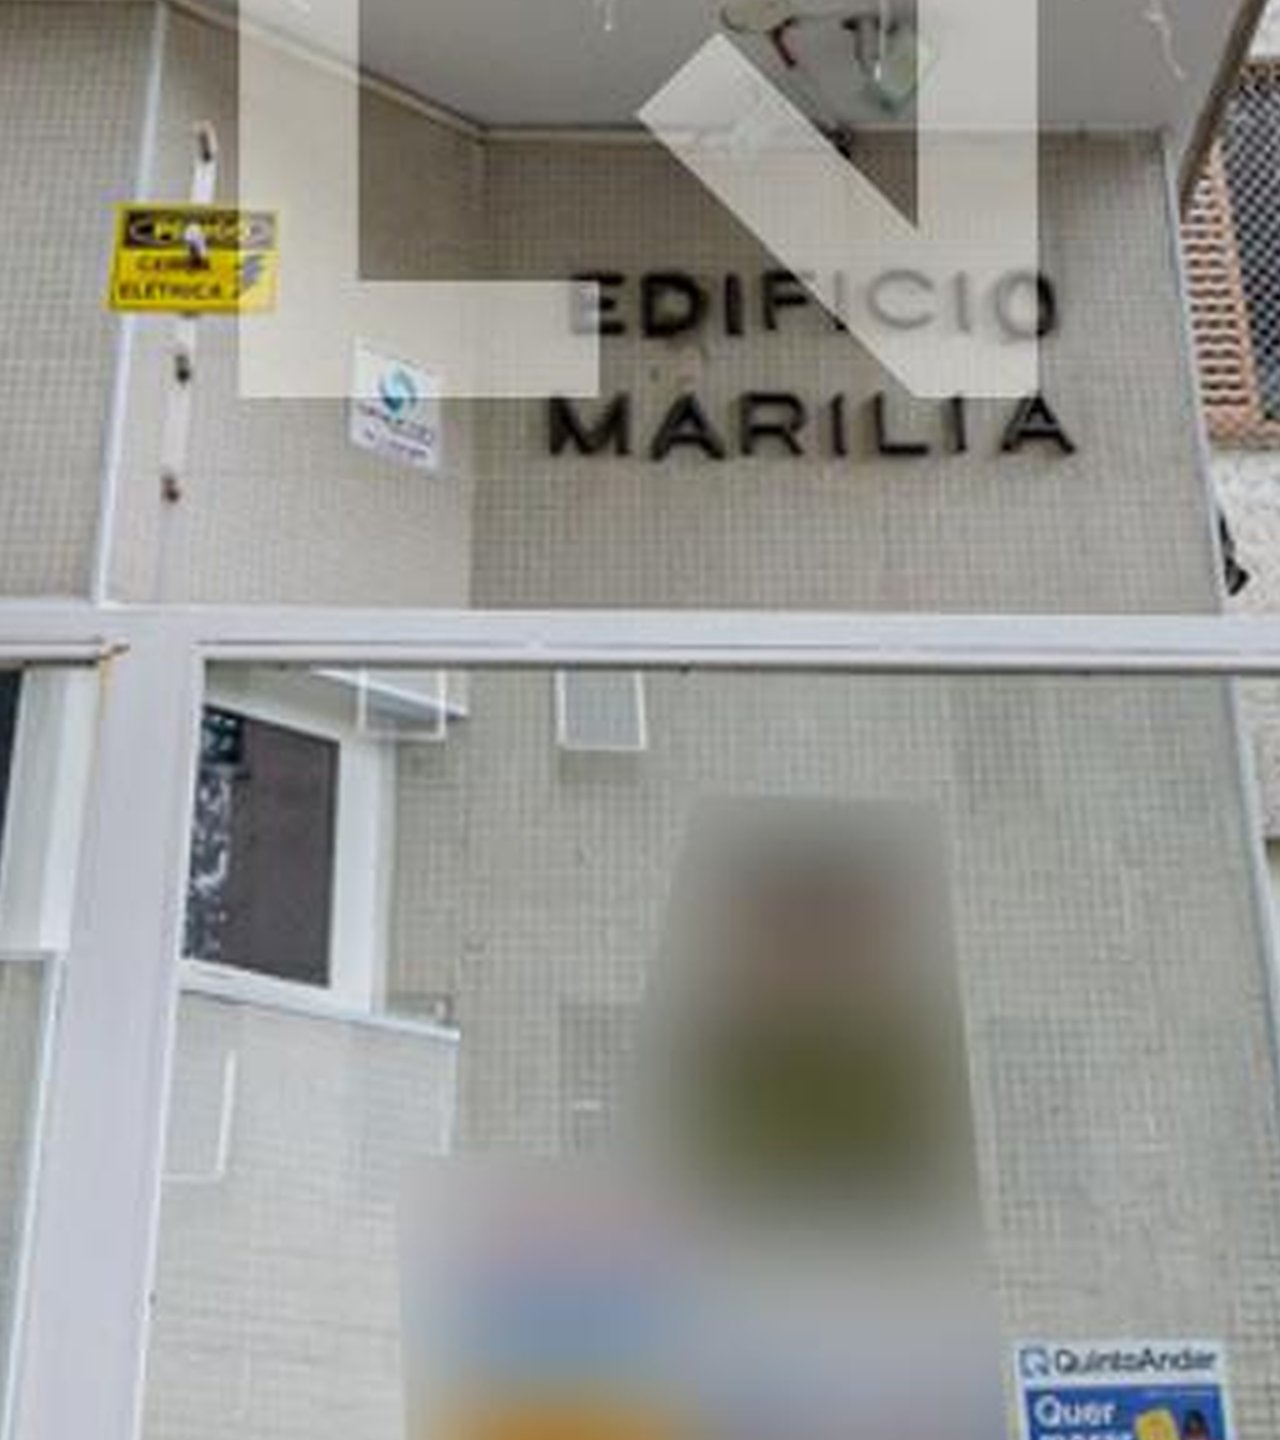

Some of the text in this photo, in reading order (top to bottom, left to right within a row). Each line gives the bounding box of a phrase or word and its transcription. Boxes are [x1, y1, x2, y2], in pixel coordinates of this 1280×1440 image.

[572, 270, 1057, 337] EDIFICIO
[548, 391, 1075, 460] MARILIA
[1055, 1347, 1216, 1374] QuintoAndar
[1035, 1395, 1116, 1426] Quer
